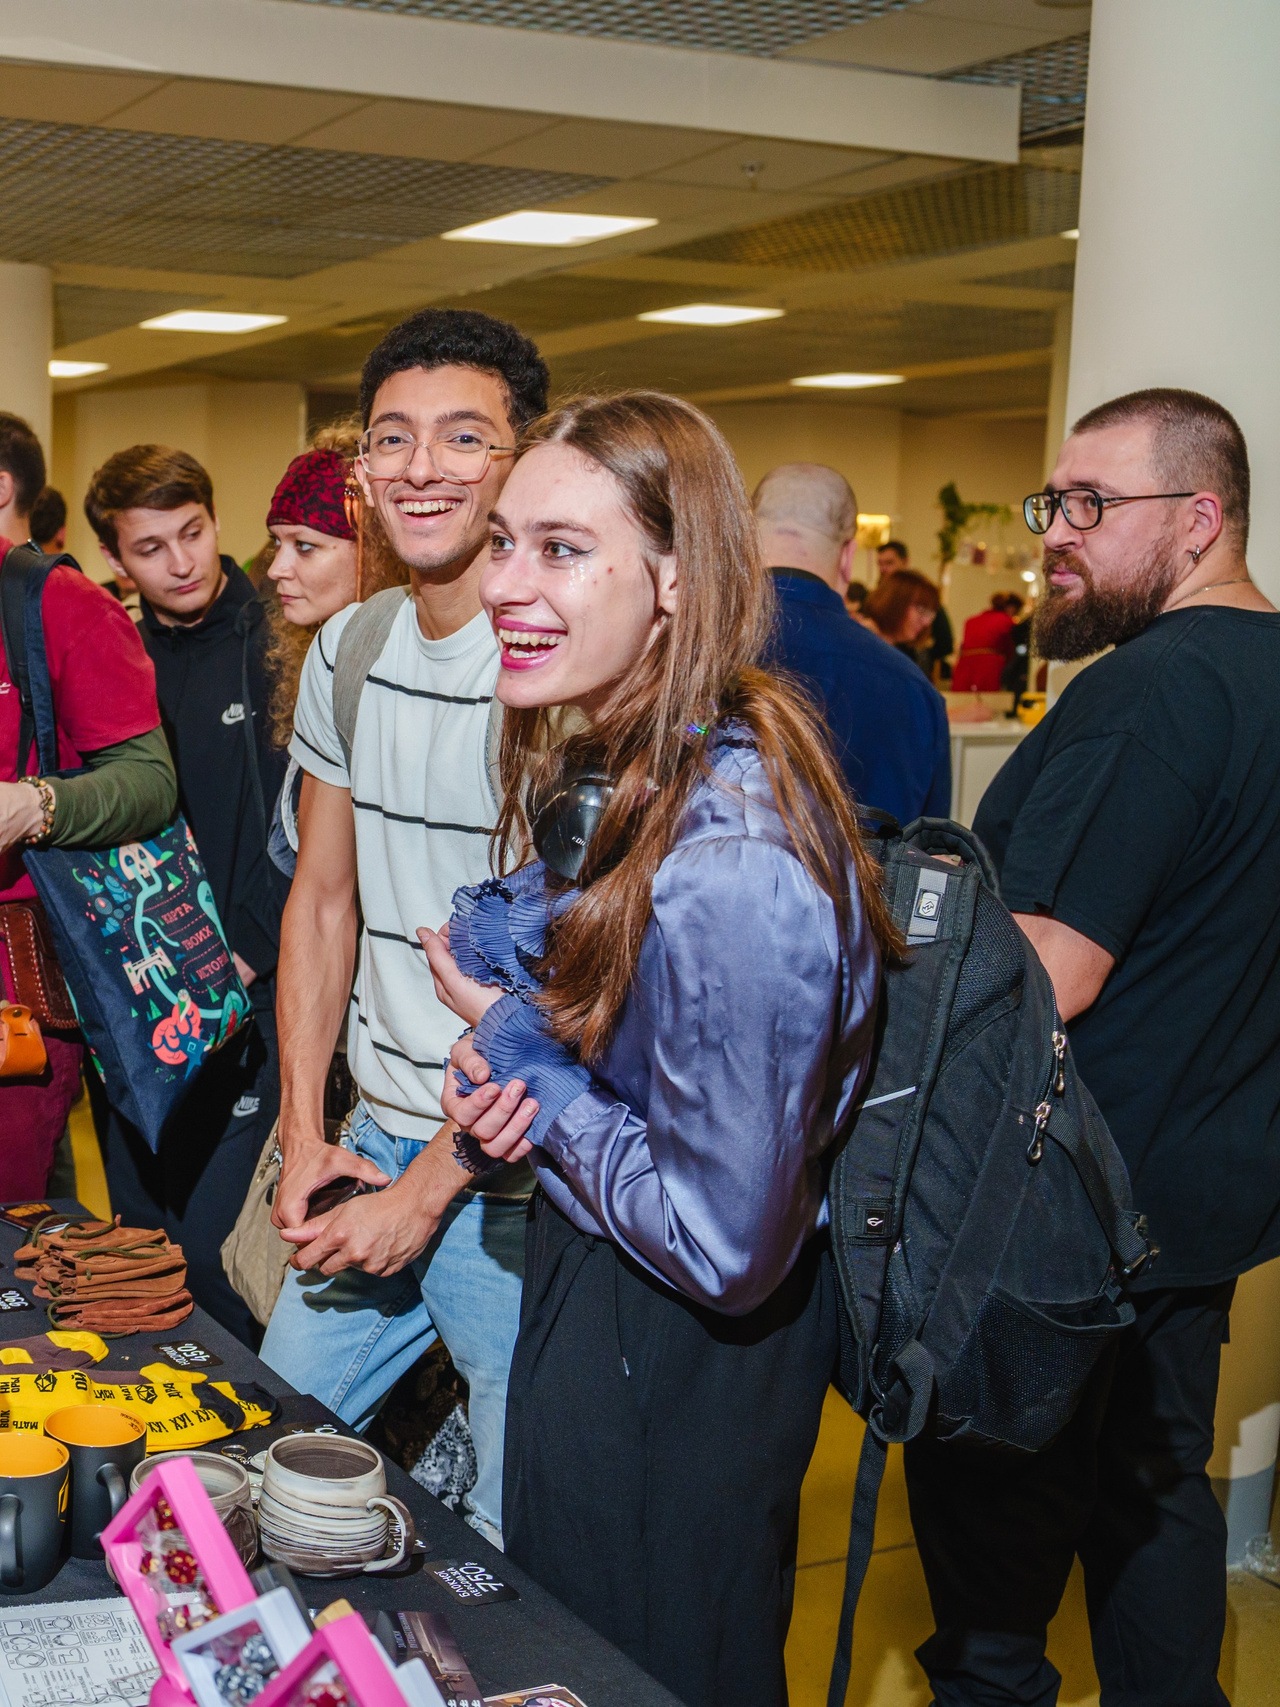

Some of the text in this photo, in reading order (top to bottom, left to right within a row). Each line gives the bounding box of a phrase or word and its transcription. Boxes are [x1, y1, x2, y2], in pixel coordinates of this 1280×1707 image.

[237, 1095, 260, 1110] NIKE
[0, 1409, 10, 1428] ВОЛК
[434, 1570, 470, 1598] БЛОКНОТ
